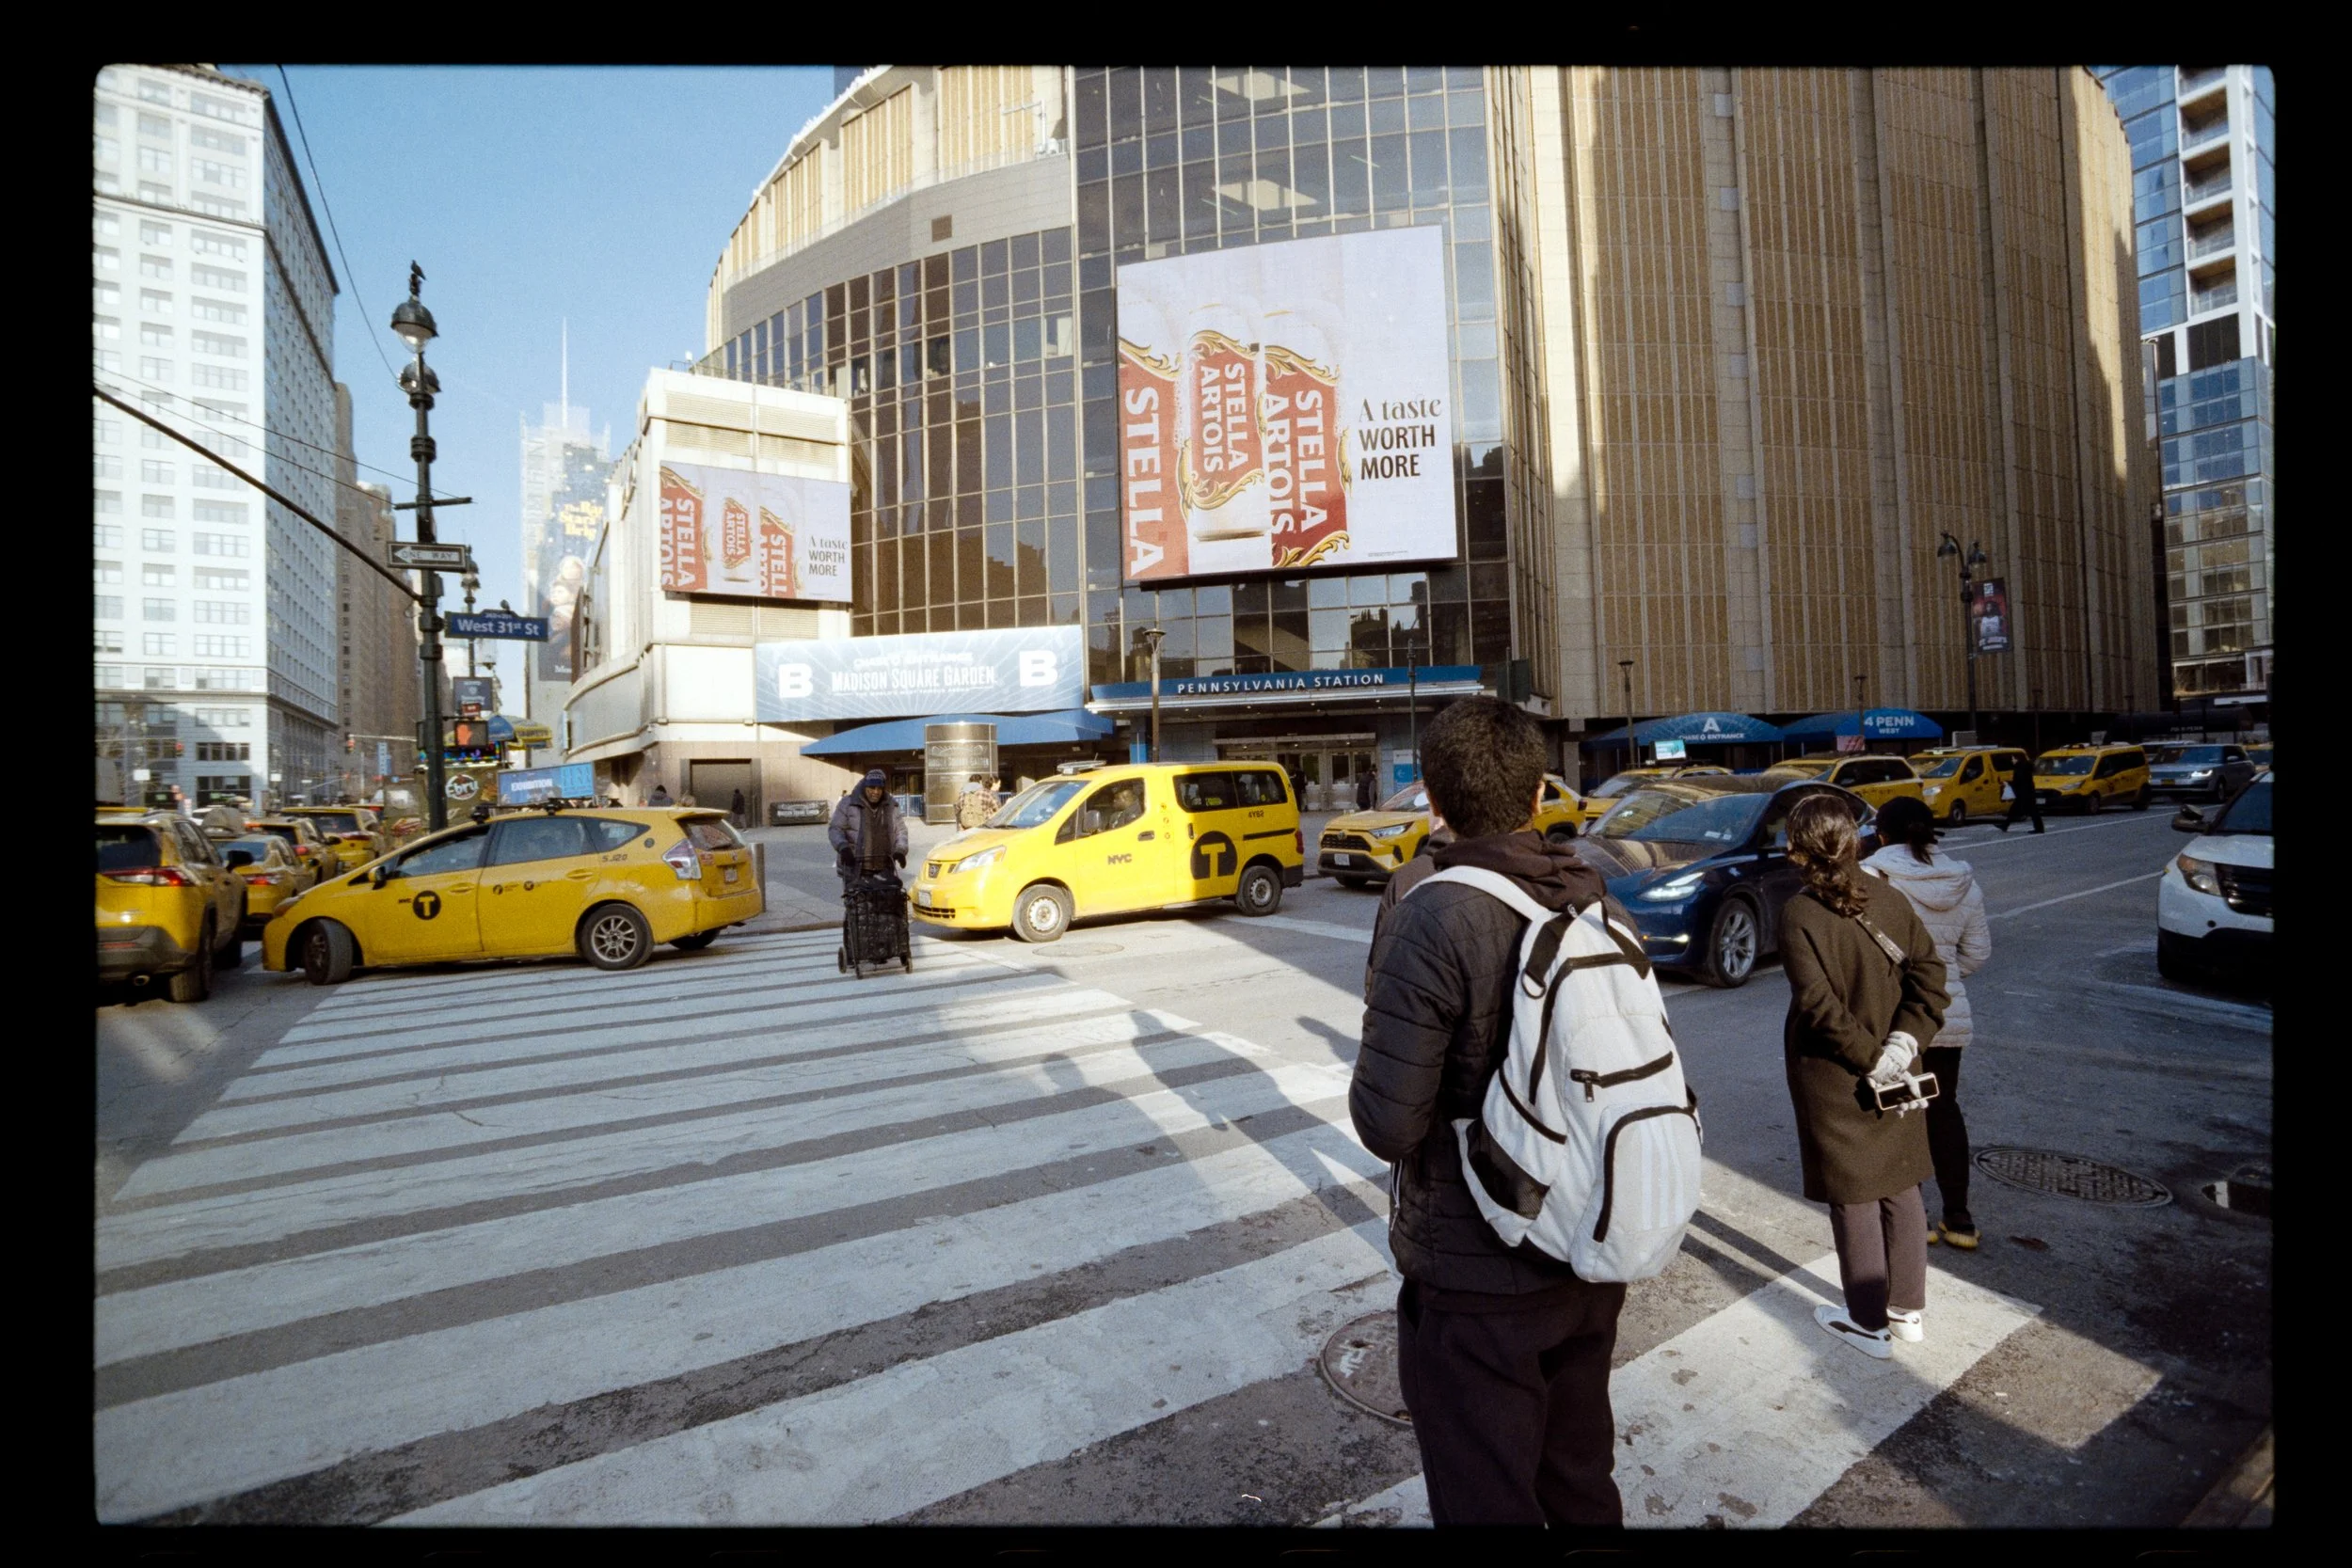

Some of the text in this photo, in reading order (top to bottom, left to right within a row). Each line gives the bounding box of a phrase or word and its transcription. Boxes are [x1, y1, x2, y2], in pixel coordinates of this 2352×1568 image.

[1200, 366, 1223, 472] ARTOIS
[1225, 362, 1248, 469] STELLA
[1359, 396, 1441, 421] A taste
[1359, 424, 1435, 451] WORTH
[1264, 393, 1294, 534] ARTOIS
[1295, 389, 1328, 532] STELLA
[1361, 454, 1421, 480] MORE
[1125, 387, 1164, 576] STELLA
[676, 498, 695, 586] STELLA
[726, 512, 737, 555] ARTOIS
[737, 513, 746, 555] STELLA
[809, 535, 848, 550] A taste
[402, 550, 421, 559] ONE
[808, 550, 845, 563] WORTH
[808, 564, 837, 576] MORE
[457, 619, 539, 636] West 31st St
[779, 663, 813, 698] B
[832, 665, 994, 692] MADISON SQUARE GARDEN
[1019, 650, 1058, 686] B
[1178, 673, 1384, 693] PENNSYLVANIA STATION
[1703, 718, 1721, 732] A
[1864, 716, 1915, 726] 4 PENN
[1108, 854, 1132, 864] NYC
[1200, 843, 1226, 879] T
[419, 896, 436, 917] T
